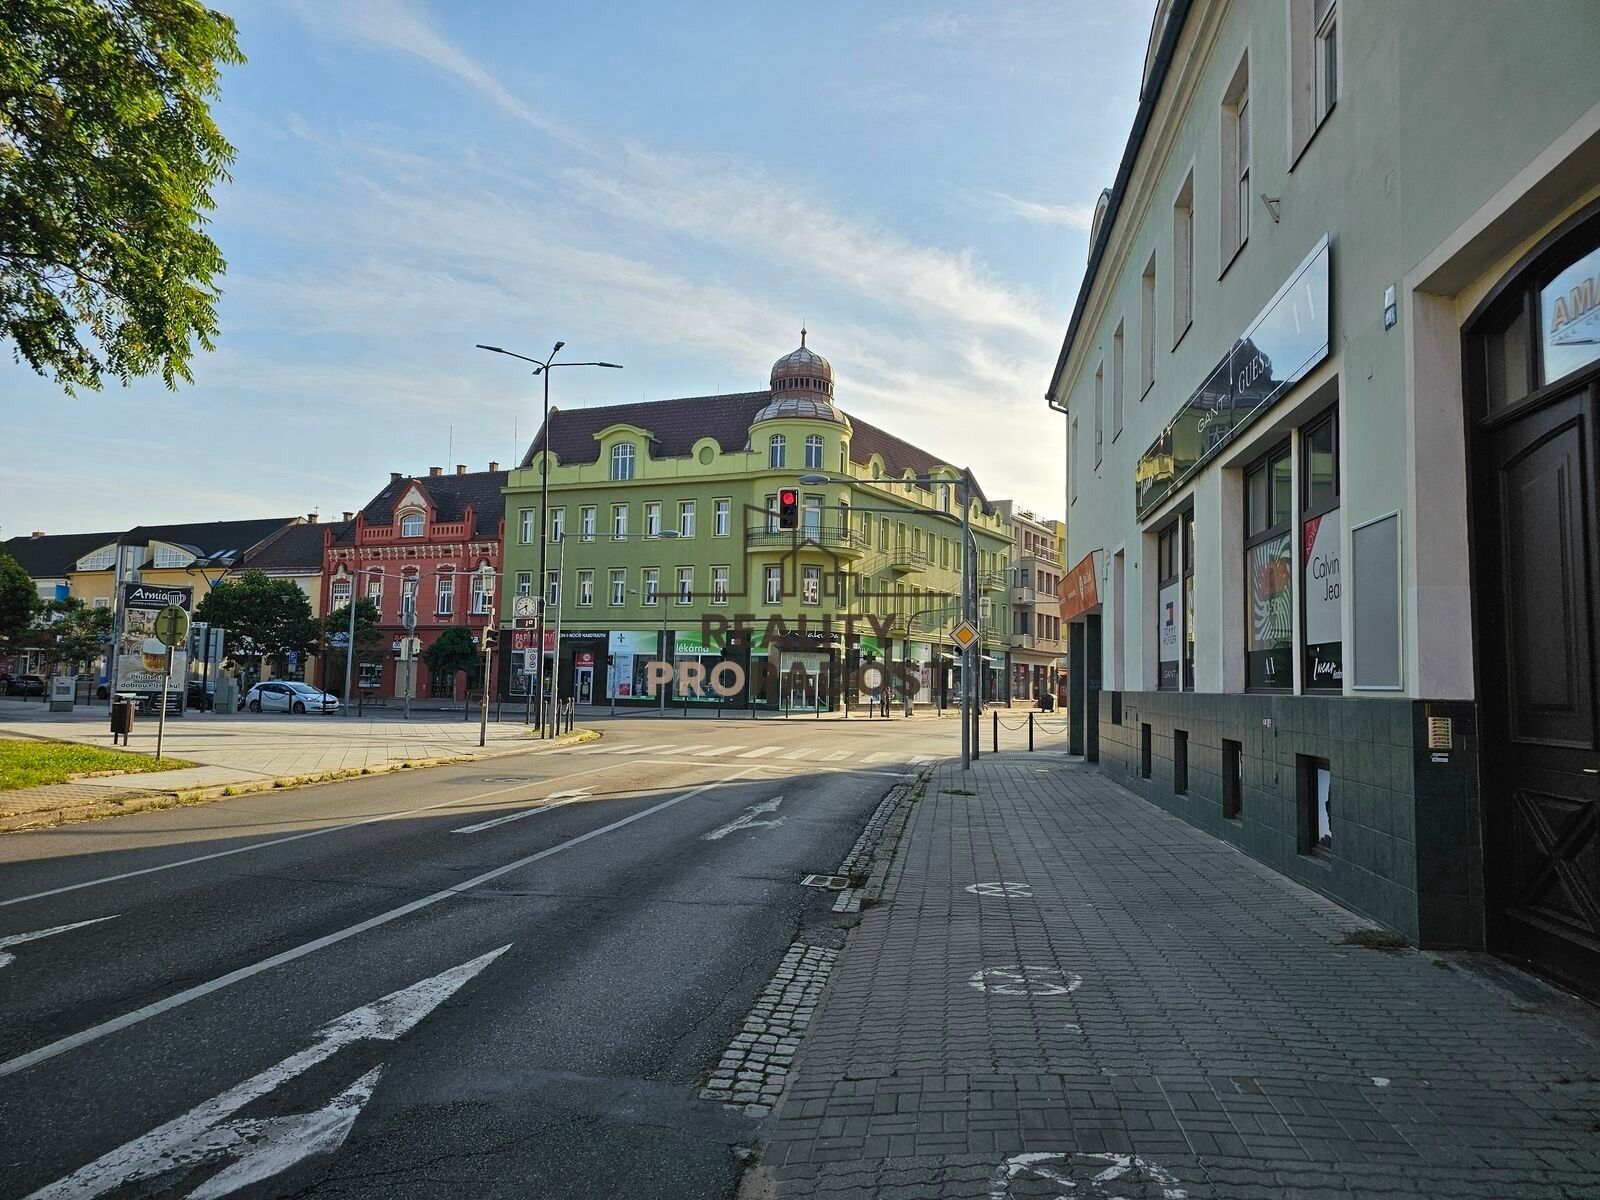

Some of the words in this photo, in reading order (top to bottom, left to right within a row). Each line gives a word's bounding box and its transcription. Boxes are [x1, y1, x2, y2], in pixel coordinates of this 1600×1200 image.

[1197, 394, 1226, 433] GANT
[1313, 551, 1340, 580] Calvin
[1323, 578, 1342, 601] Jea
[1163, 670, 1177, 679] GANT
